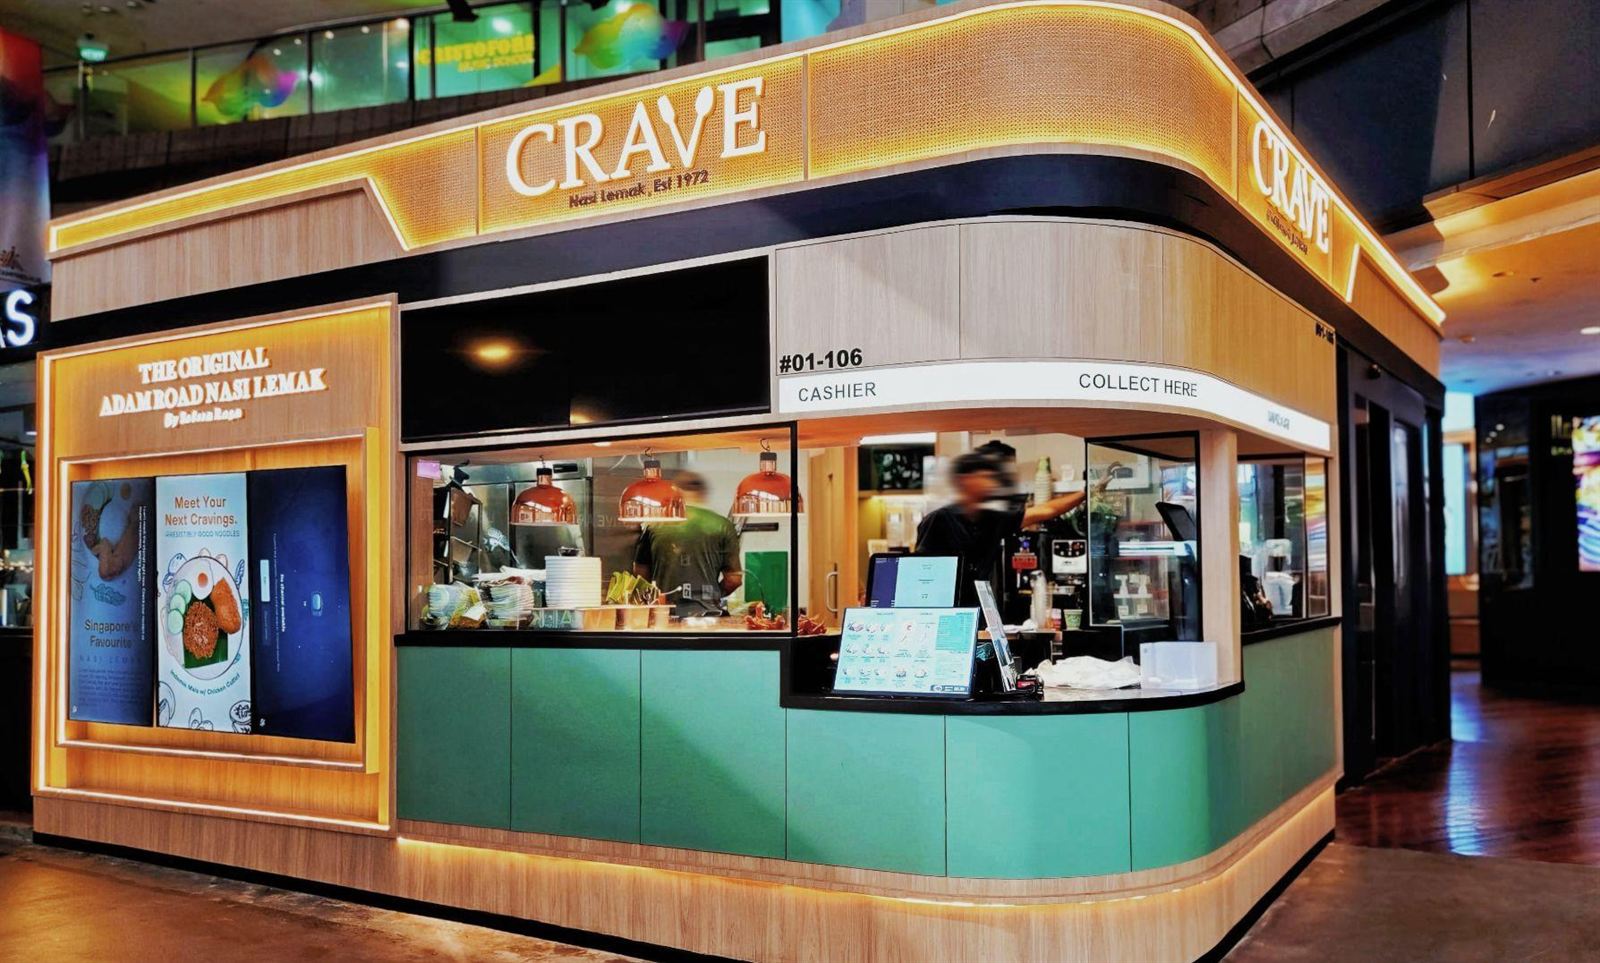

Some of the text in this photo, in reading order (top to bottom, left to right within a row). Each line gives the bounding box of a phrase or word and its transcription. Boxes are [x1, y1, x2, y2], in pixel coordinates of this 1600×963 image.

[506, 77, 766, 197] CRAVE
[569, 191, 597, 208] Nasi
[653, 176, 672, 193] Est
[676, 169, 709, 188] 1972
[1252, 120, 1330, 254] CRAVE
[0, 288, 36, 347] S
[138, 346, 270, 385] THE ORIGINAL
[779, 347, 864, 373] #01-106
[98, 367, 328, 417] ADAM ROAD NASI LEMAK
[798, 382, 877, 402] CASHIER
[1079, 373, 1199, 398] COLLECT HERE
[164, 411, 180, 429] By
[174, 495, 227, 509] Meet Your
[164, 512, 238, 528] Next Cravings.
